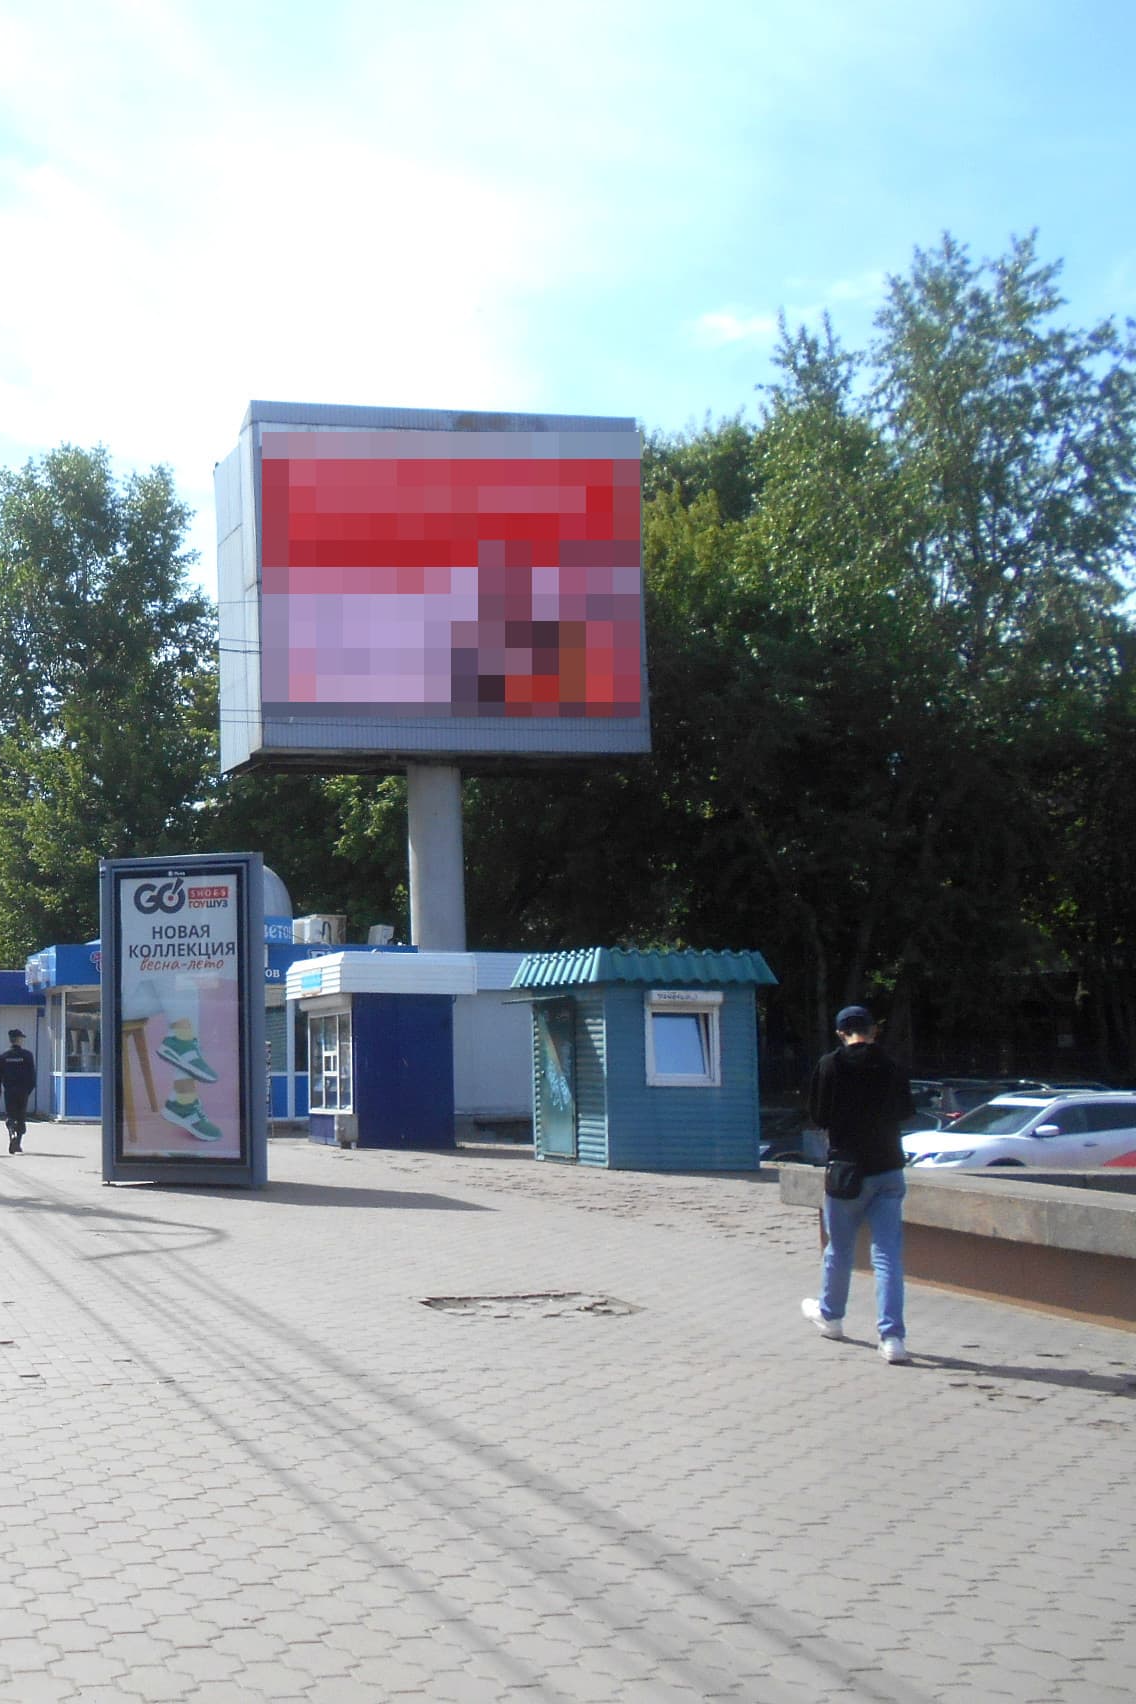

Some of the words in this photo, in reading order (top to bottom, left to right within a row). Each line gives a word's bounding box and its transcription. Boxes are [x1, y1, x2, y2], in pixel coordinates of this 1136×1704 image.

[190, 888, 227, 899] SHOES
[189, 899, 229, 909] ГОУШУЗ
[152, 924, 210, 940] НОВАЯ
[129, 941, 236, 959] КОЛЛЕКЦИЯ
[139, 957, 225, 971] весна-лето
